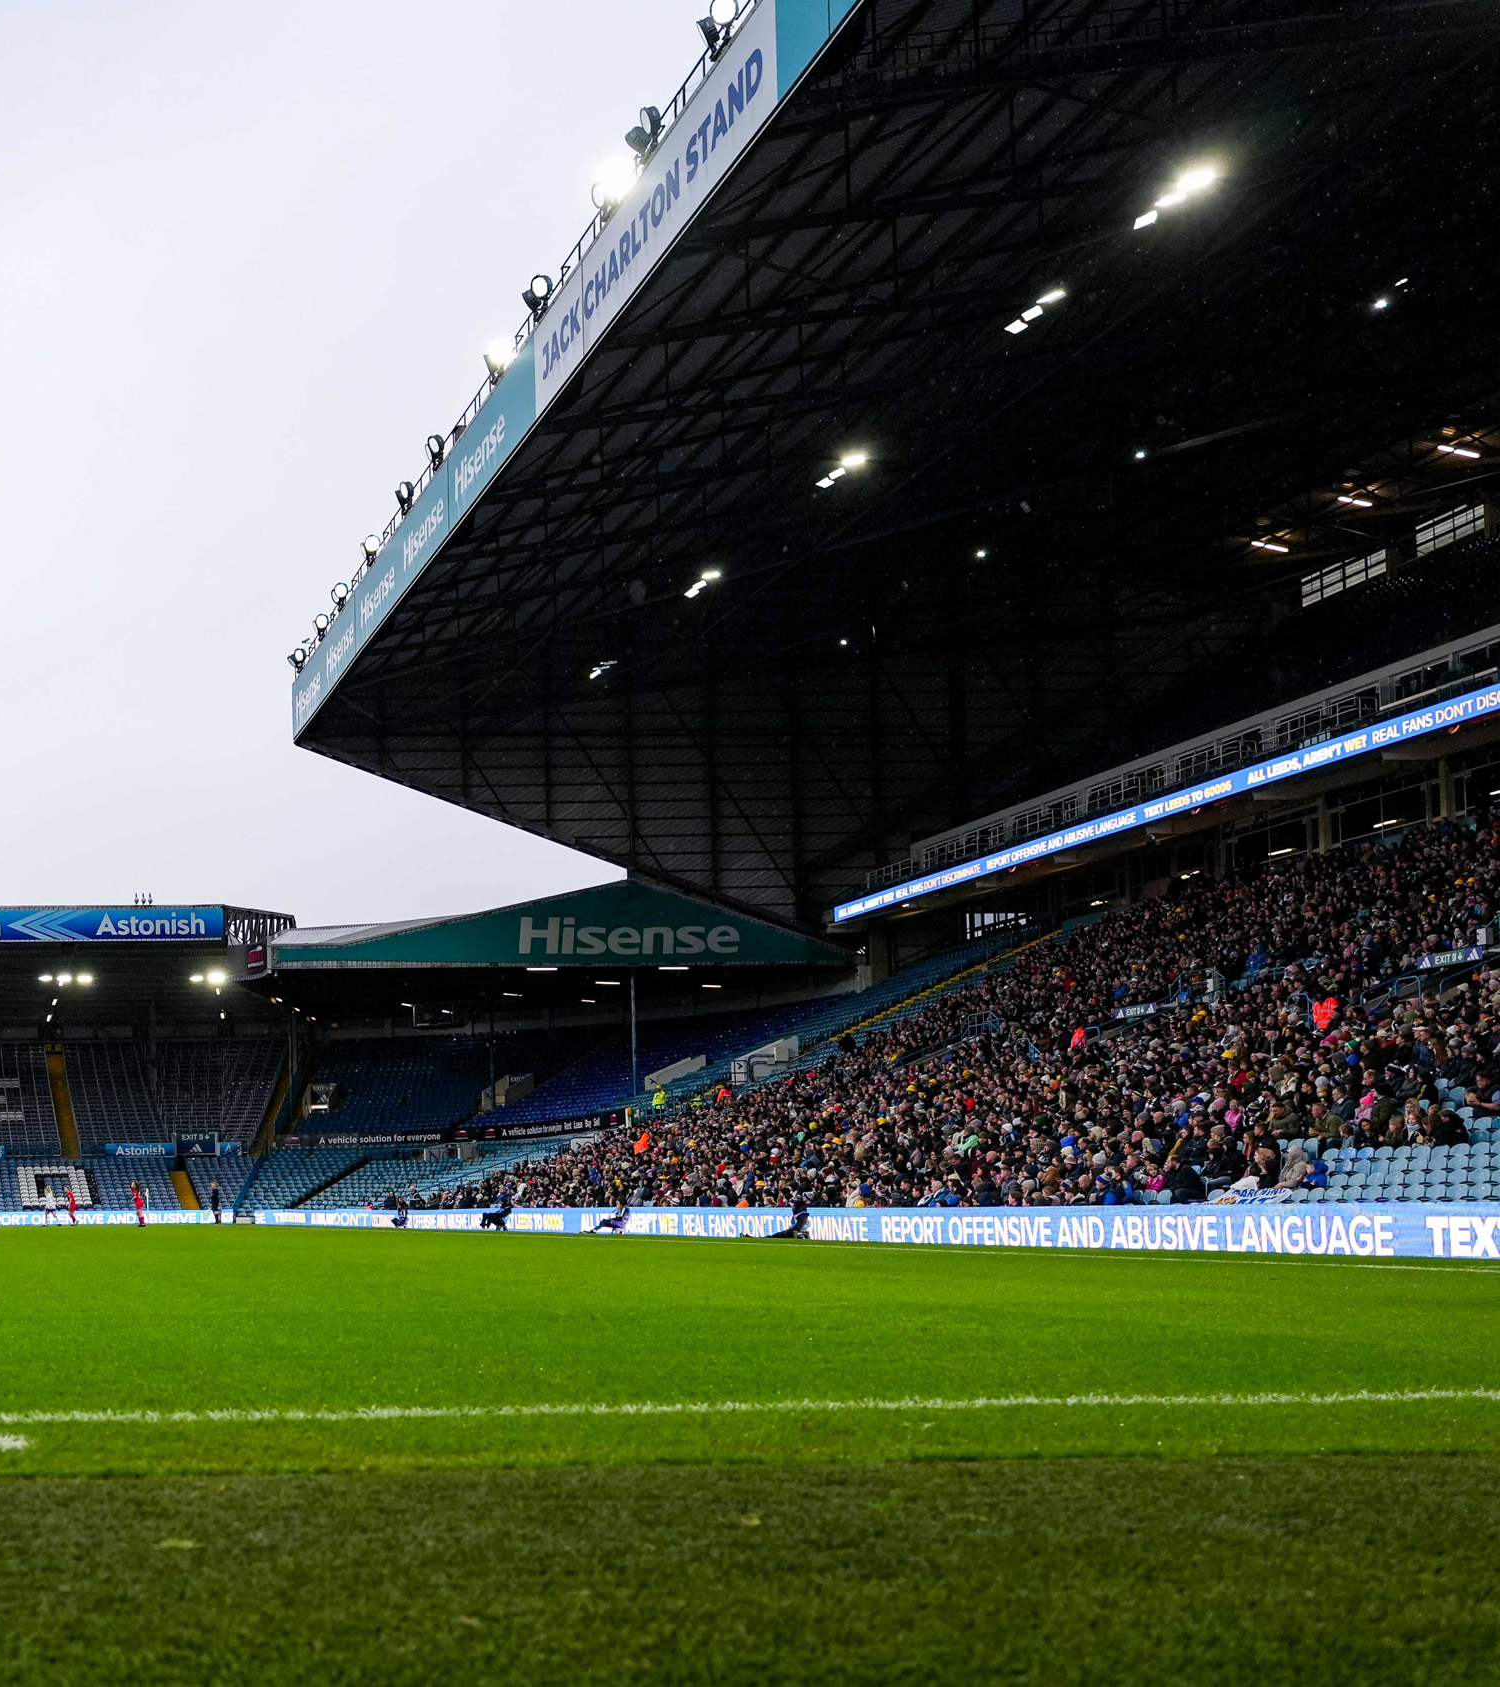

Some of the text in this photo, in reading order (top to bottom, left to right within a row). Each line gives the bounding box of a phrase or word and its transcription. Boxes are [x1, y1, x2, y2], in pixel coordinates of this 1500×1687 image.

[543, 48, 762, 380] JACK CHARLTON STAND
[454, 414, 505, 501] Hisense
[403, 498, 443, 570] Hisense
[360, 566, 395, 628] Hisense
[326, 622, 354, 676] Hisense
[296, 671, 321, 718] Hisense
[986, 854, 1010, 870] REPORT
[1012, 843, 1047, 862] OFFENSIVE
[1048, 836, 1063, 850] AND
[1064, 827, 1094, 846] ABUSIVE
[1095, 812, 1136, 838] LANGUAGE
[1144, 805, 1164, 819] TEXT
[1165, 796, 1190, 812] LEEDS
[1190, 792, 1203, 803] TO
[1204, 780, 1232, 800] 60006
[1247, 769, 1265, 785] ALL
[1303, 743, 1342, 768] AREN'T
[1344, 735, 1367, 753] WE?
[1372, 724, 1401, 744] REAL
[1402, 713, 1433, 735] FANS
[1435, 699, 1474, 724] DON'T
[96, 912, 205, 936] Astonish
[518, 917, 740, 954] Hisense
[1435, 954, 1451, 964] EXIT
[116, 1145, 165, 1156] Astonish
[328, 1136, 357, 1145] vehicle
[359, 1135, 392, 1144] solution
[393, 1134, 406, 1143] for
[407, 1133, 441, 1143] everyone
[107, 1212, 140, 1224] AND
[143, 1212, 196, 1224] ABUSIVE
[334, 1213, 369, 1226] DON'T
[533, 1214, 542, 1231] TO
[659, 1213, 678, 1235] WE?
[683, 1214, 708, 1237] REAL
[709, 1215, 737, 1238] FANS
[738, 1215, 775, 1238] DON'T
[881, 1216, 944, 1244] REPORT
[949, 1216, 1053, 1247] OFFENSIVE
[1057, 1216, 1104, 1249] AND
[1111, 1216, 1219, 1251] ABUSIVE
[1225, 1216, 1394, 1256] LANGUAGE
[1426, 1216, 1500, 1257] TEX
